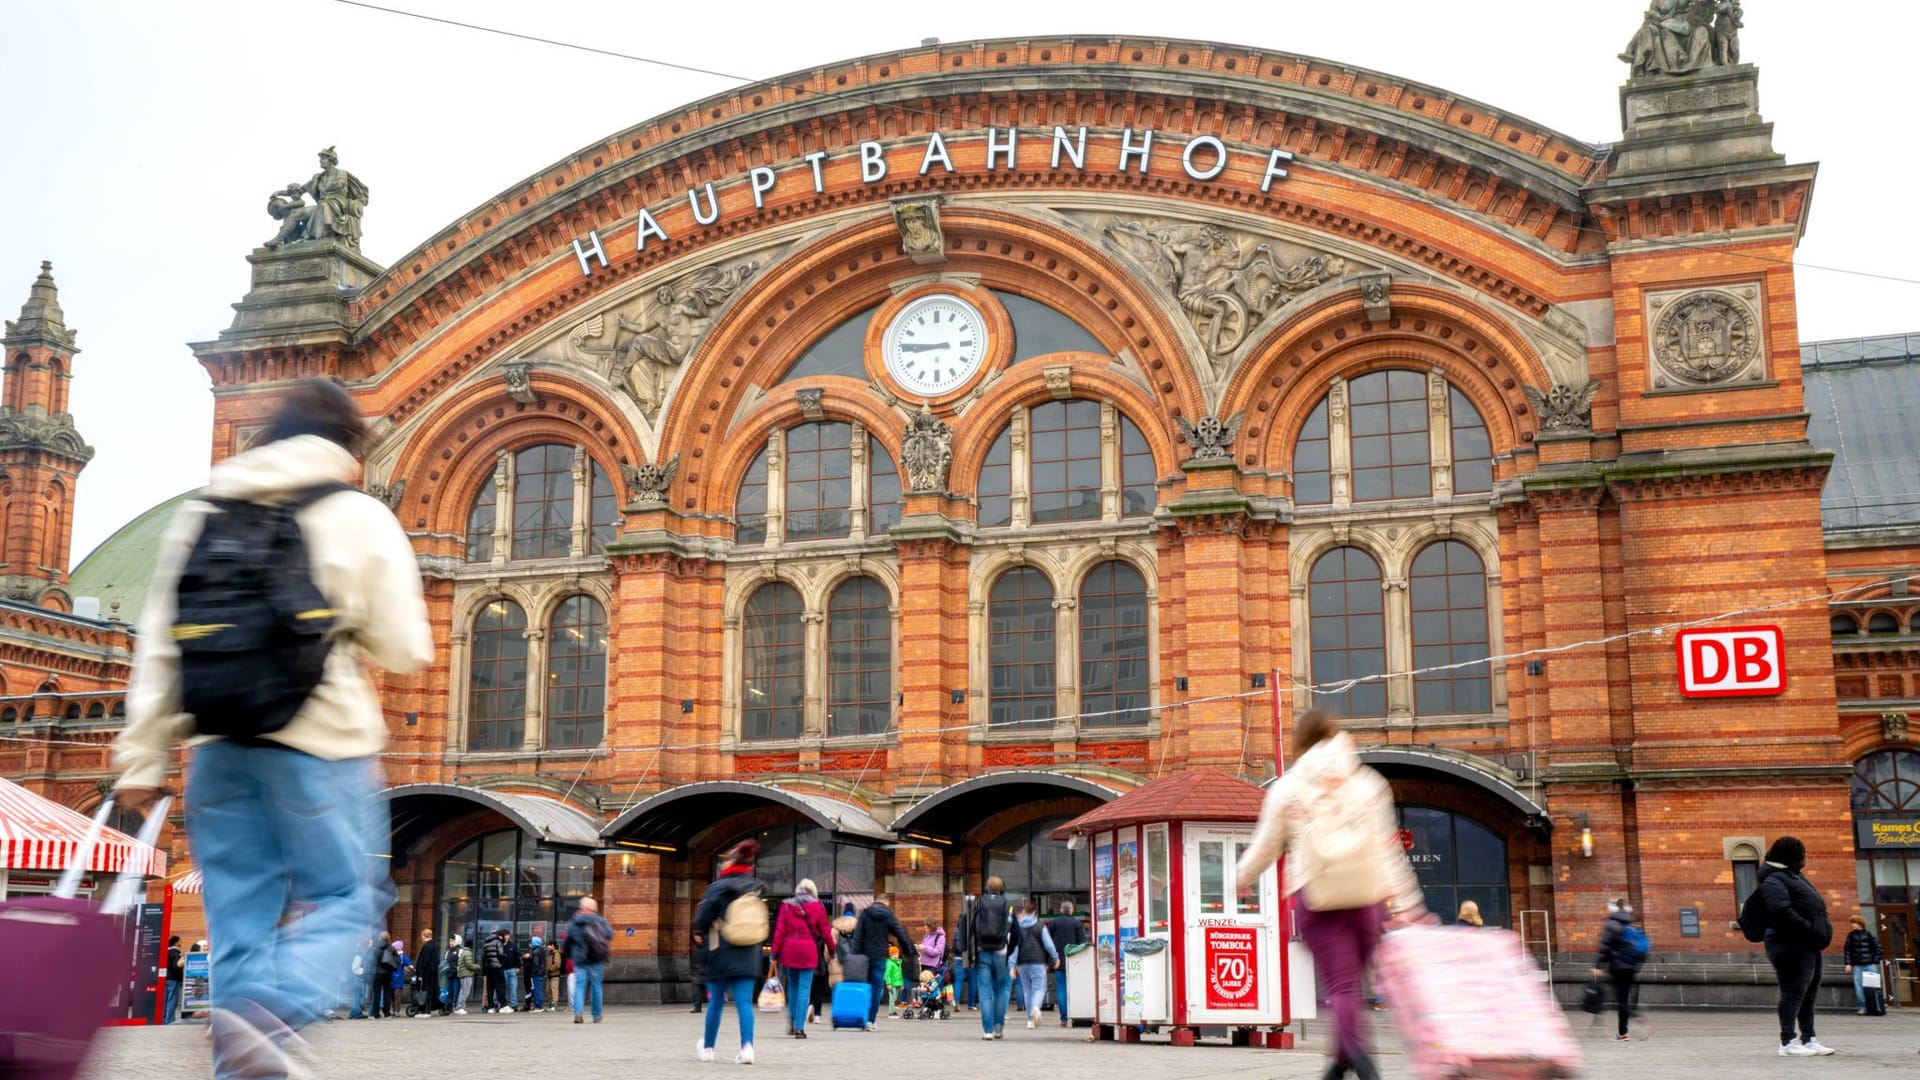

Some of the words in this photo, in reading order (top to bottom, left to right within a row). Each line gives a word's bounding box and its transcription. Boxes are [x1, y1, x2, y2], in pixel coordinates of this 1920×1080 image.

[571, 124, 1294, 277] HAUPTBAHNHOF
[1690, 637, 1773, 685] DB
[1872, 822, 1912, 833] Kamps
[1210, 941, 1253, 950] TOMBOLA
[1127, 960, 1142, 970] LOS
[1219, 958, 1245, 980] 70
